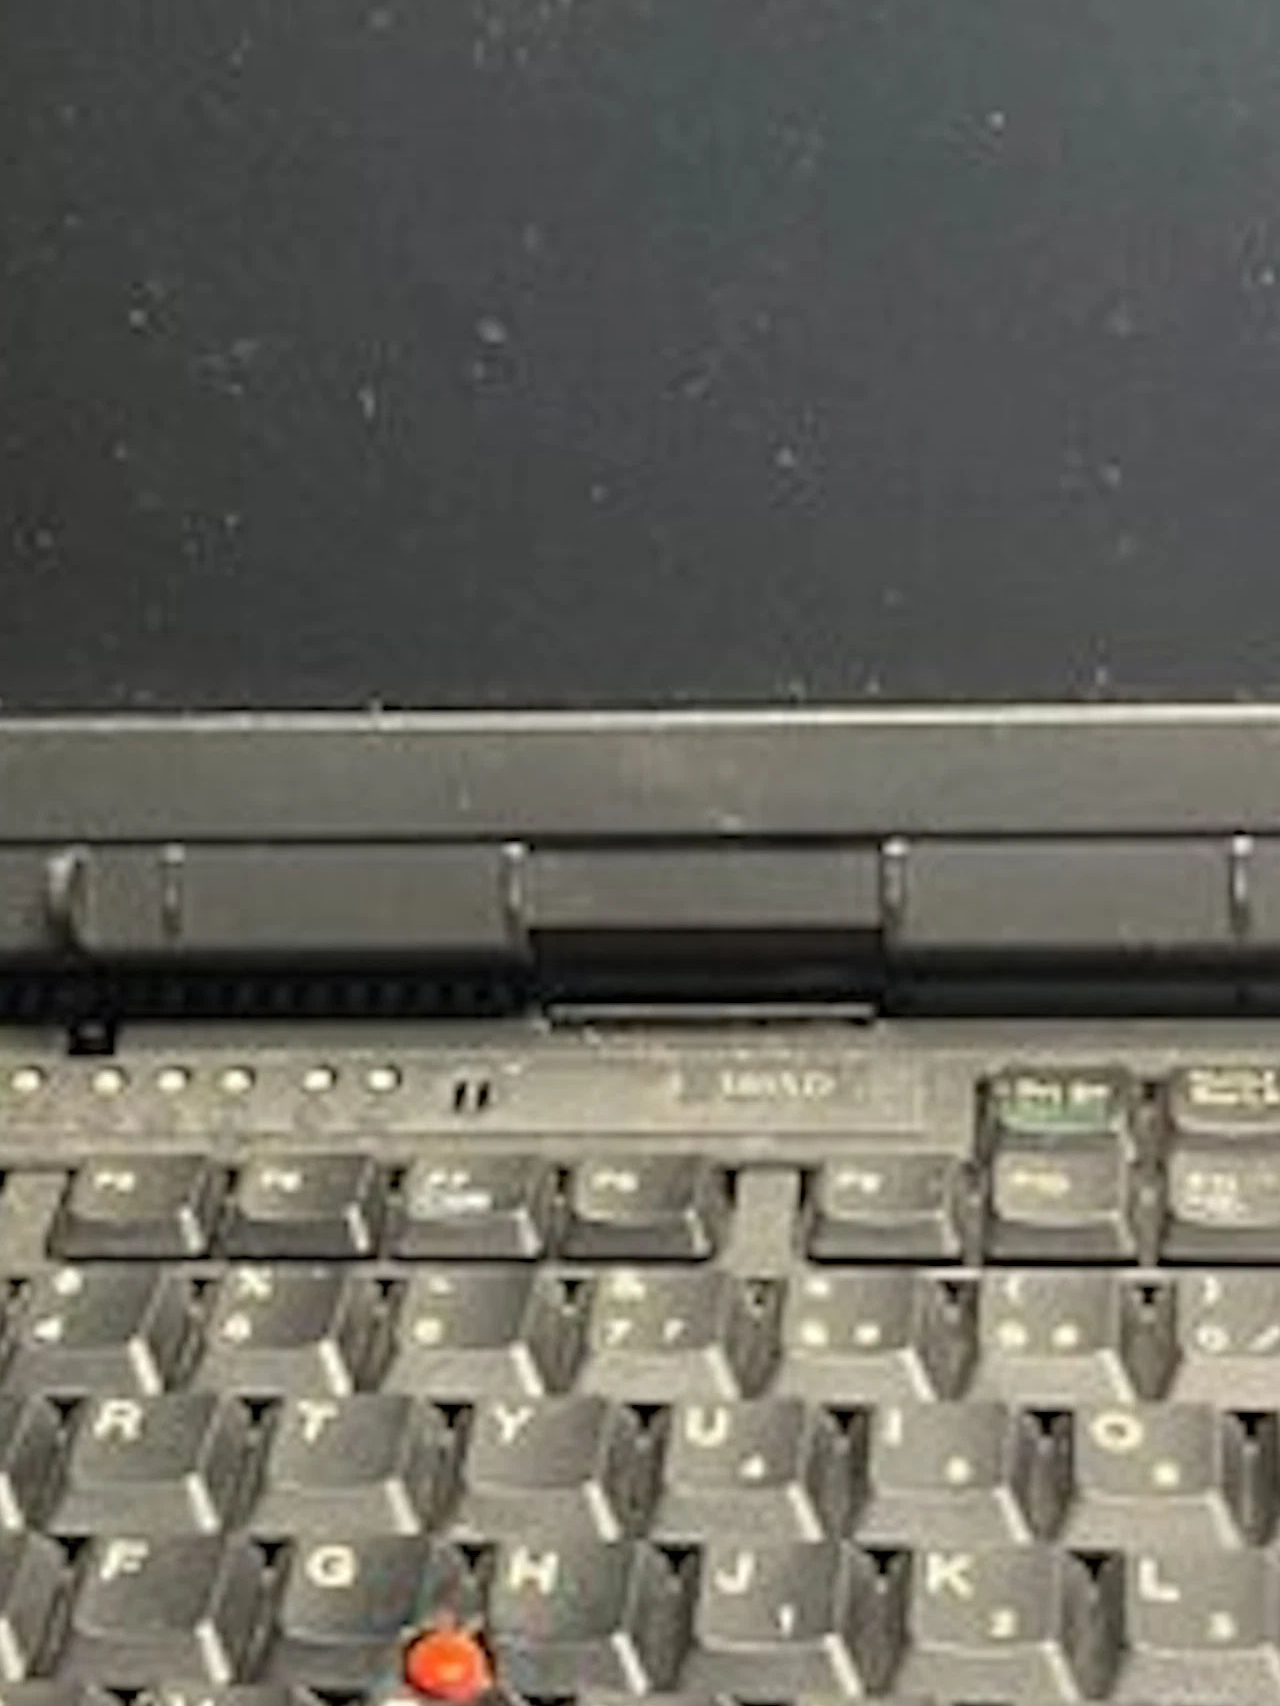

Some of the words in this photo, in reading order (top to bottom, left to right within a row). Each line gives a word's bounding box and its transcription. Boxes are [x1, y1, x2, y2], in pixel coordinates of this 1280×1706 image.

[92, 1398, 144, 1440] R
[295, 1398, 338, 1443] T
[492, 1403, 534, 1443] Y
[684, 1406, 730, 1448] U
[883, 1407, 903, 1446] I
[1089, 1410, 1145, 1452] O
[98, 1538, 149, 1582] F
[305, 1544, 355, 1588] G
[506, 1546, 559, 1594] H
[714, 1552, 755, 1594] J
[925, 1552, 973, 1597] K
[1138, 1557, 1182, 1603] L
